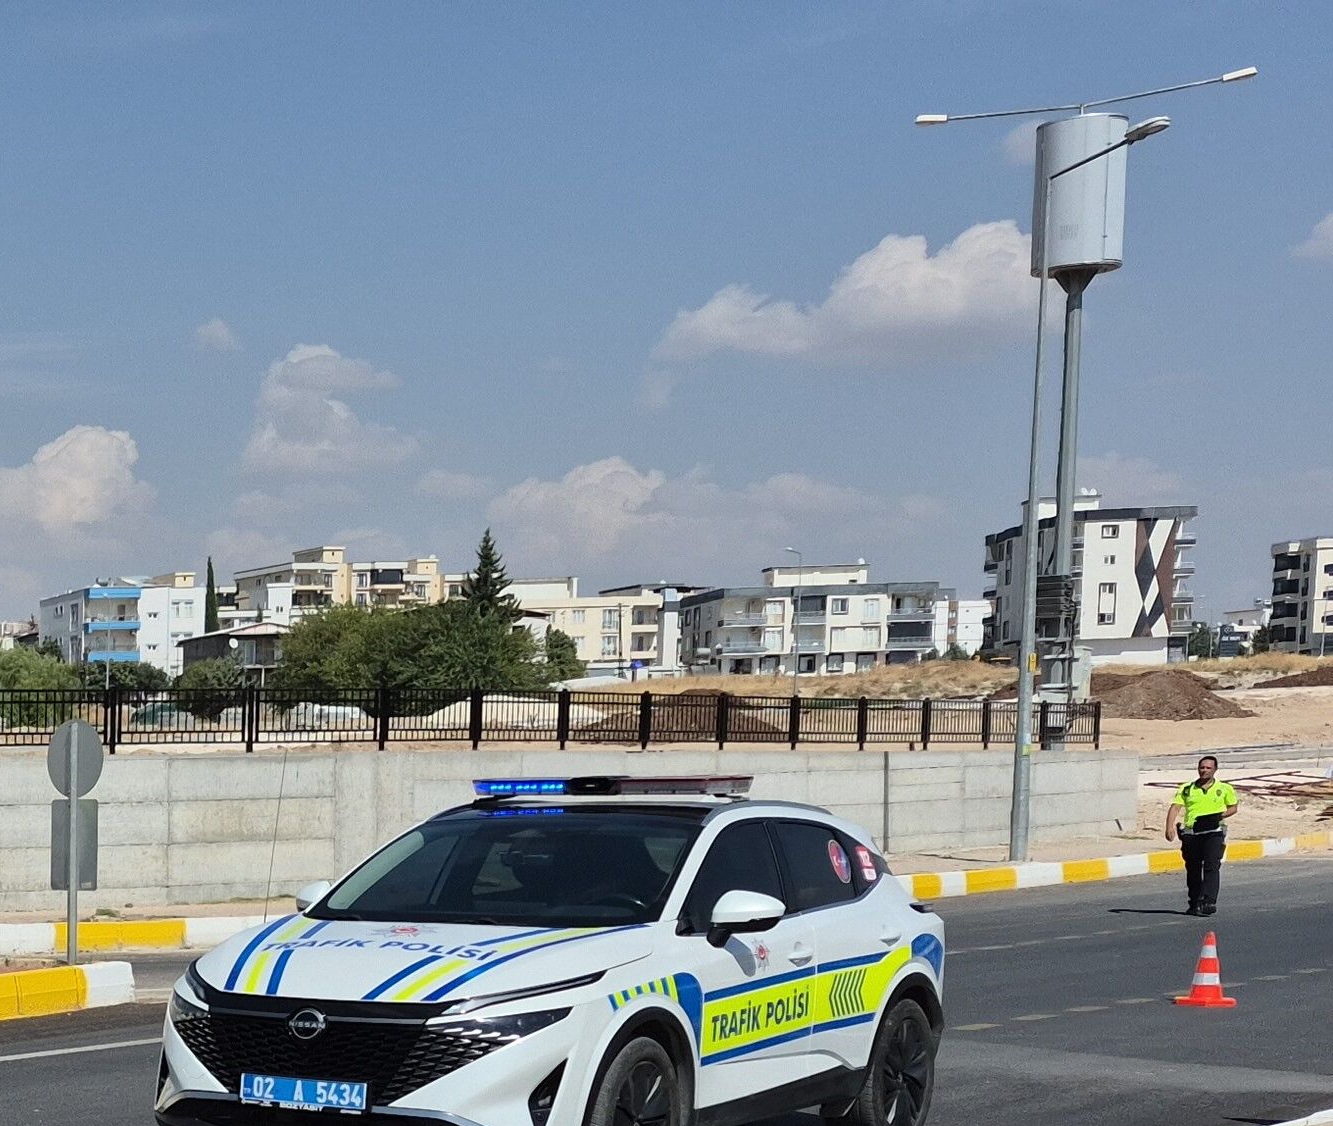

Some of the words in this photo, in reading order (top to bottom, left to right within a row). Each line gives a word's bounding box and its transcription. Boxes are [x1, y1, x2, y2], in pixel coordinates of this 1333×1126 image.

[260, 938, 373, 952] TRAFİK
[380, 939, 500, 961] POLİSİ
[288, 1021, 326, 1029] NISSAN
[711, 1000, 762, 1042] TRAFİK
[765, 984, 810, 1028] POLİSİ
[253, 1076, 275, 1099] 02
[293, 1080, 304, 1102] A
[316, 1082, 362, 1107] 5434
